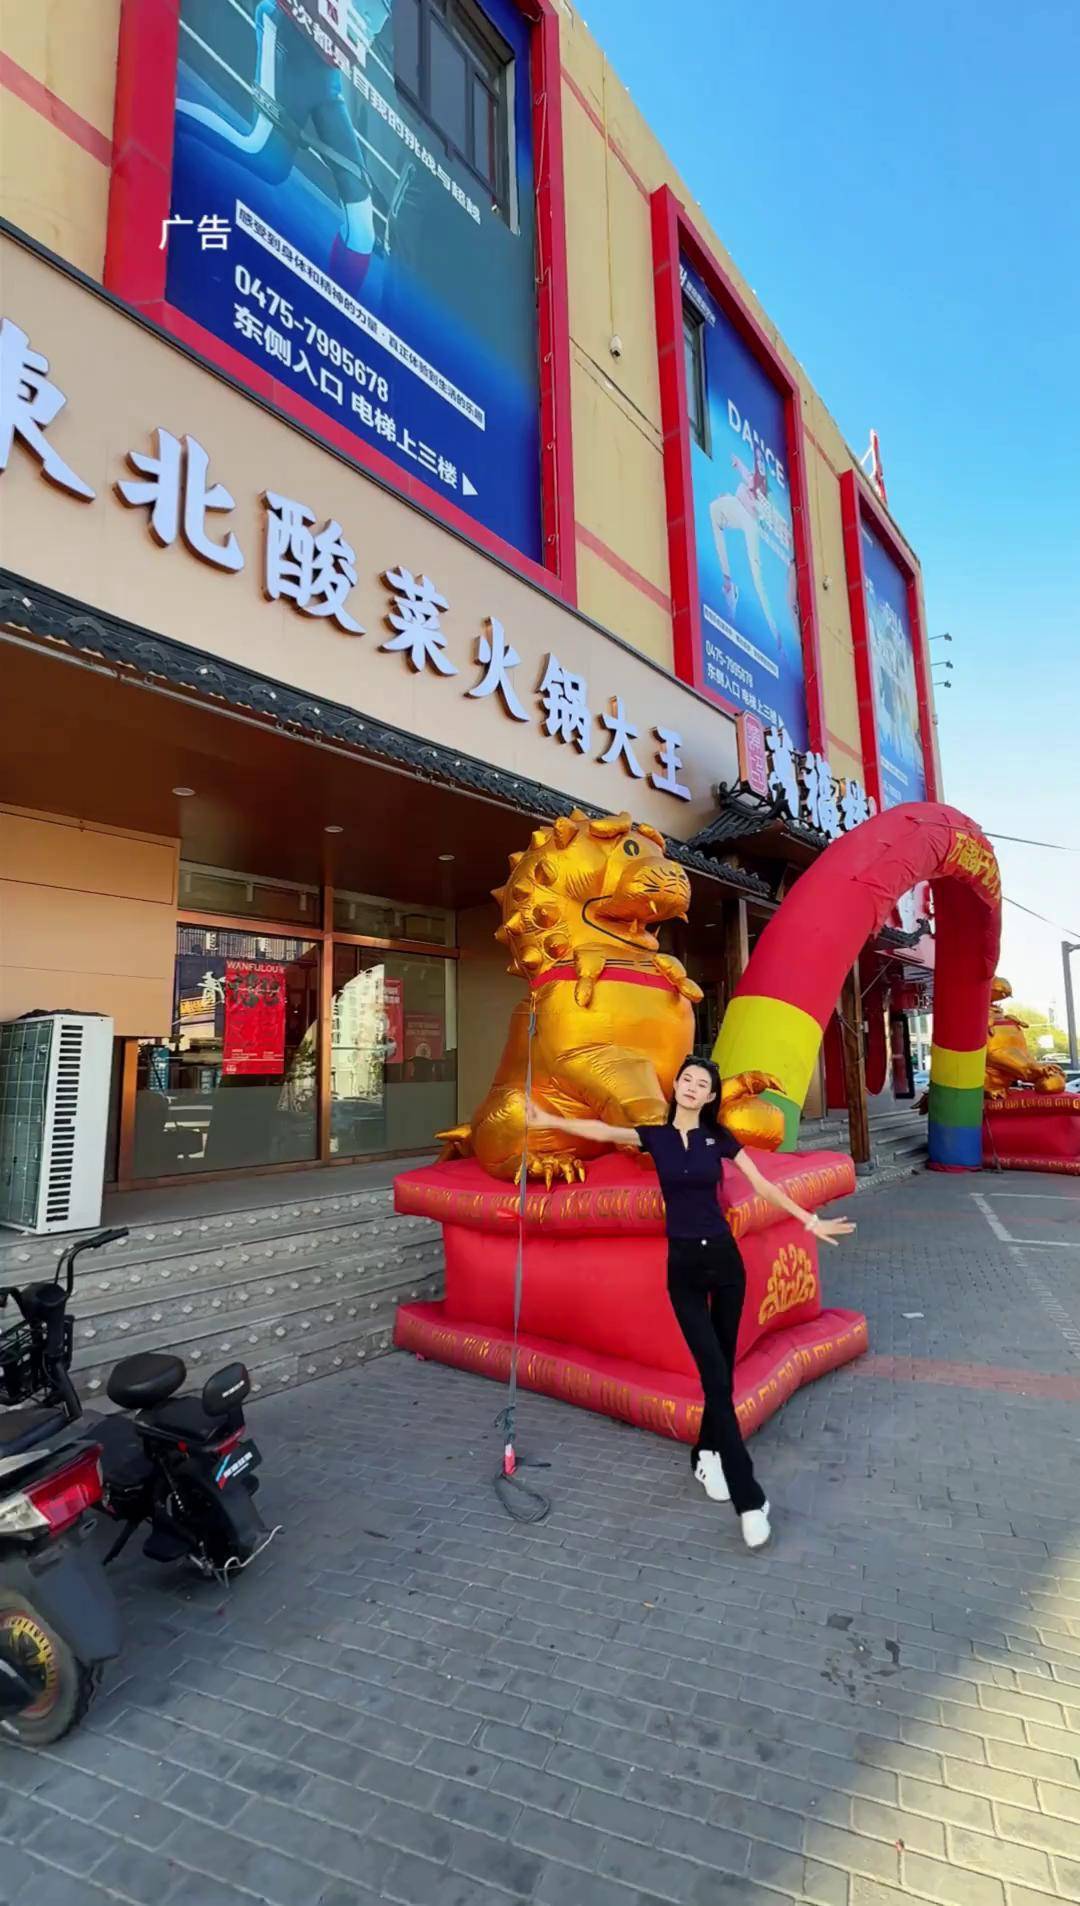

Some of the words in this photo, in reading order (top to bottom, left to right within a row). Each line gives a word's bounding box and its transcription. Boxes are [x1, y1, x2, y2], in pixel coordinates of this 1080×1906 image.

[289, 0, 482, 226] 次都是自我的挑战与超越
[232, 303, 344, 405] 东侧入口
[351, 391, 458, 491] 电梯上三楼
[234, 264, 390, 403] 0475-7995678
[226, 960, 279, 974] WANFULOU
